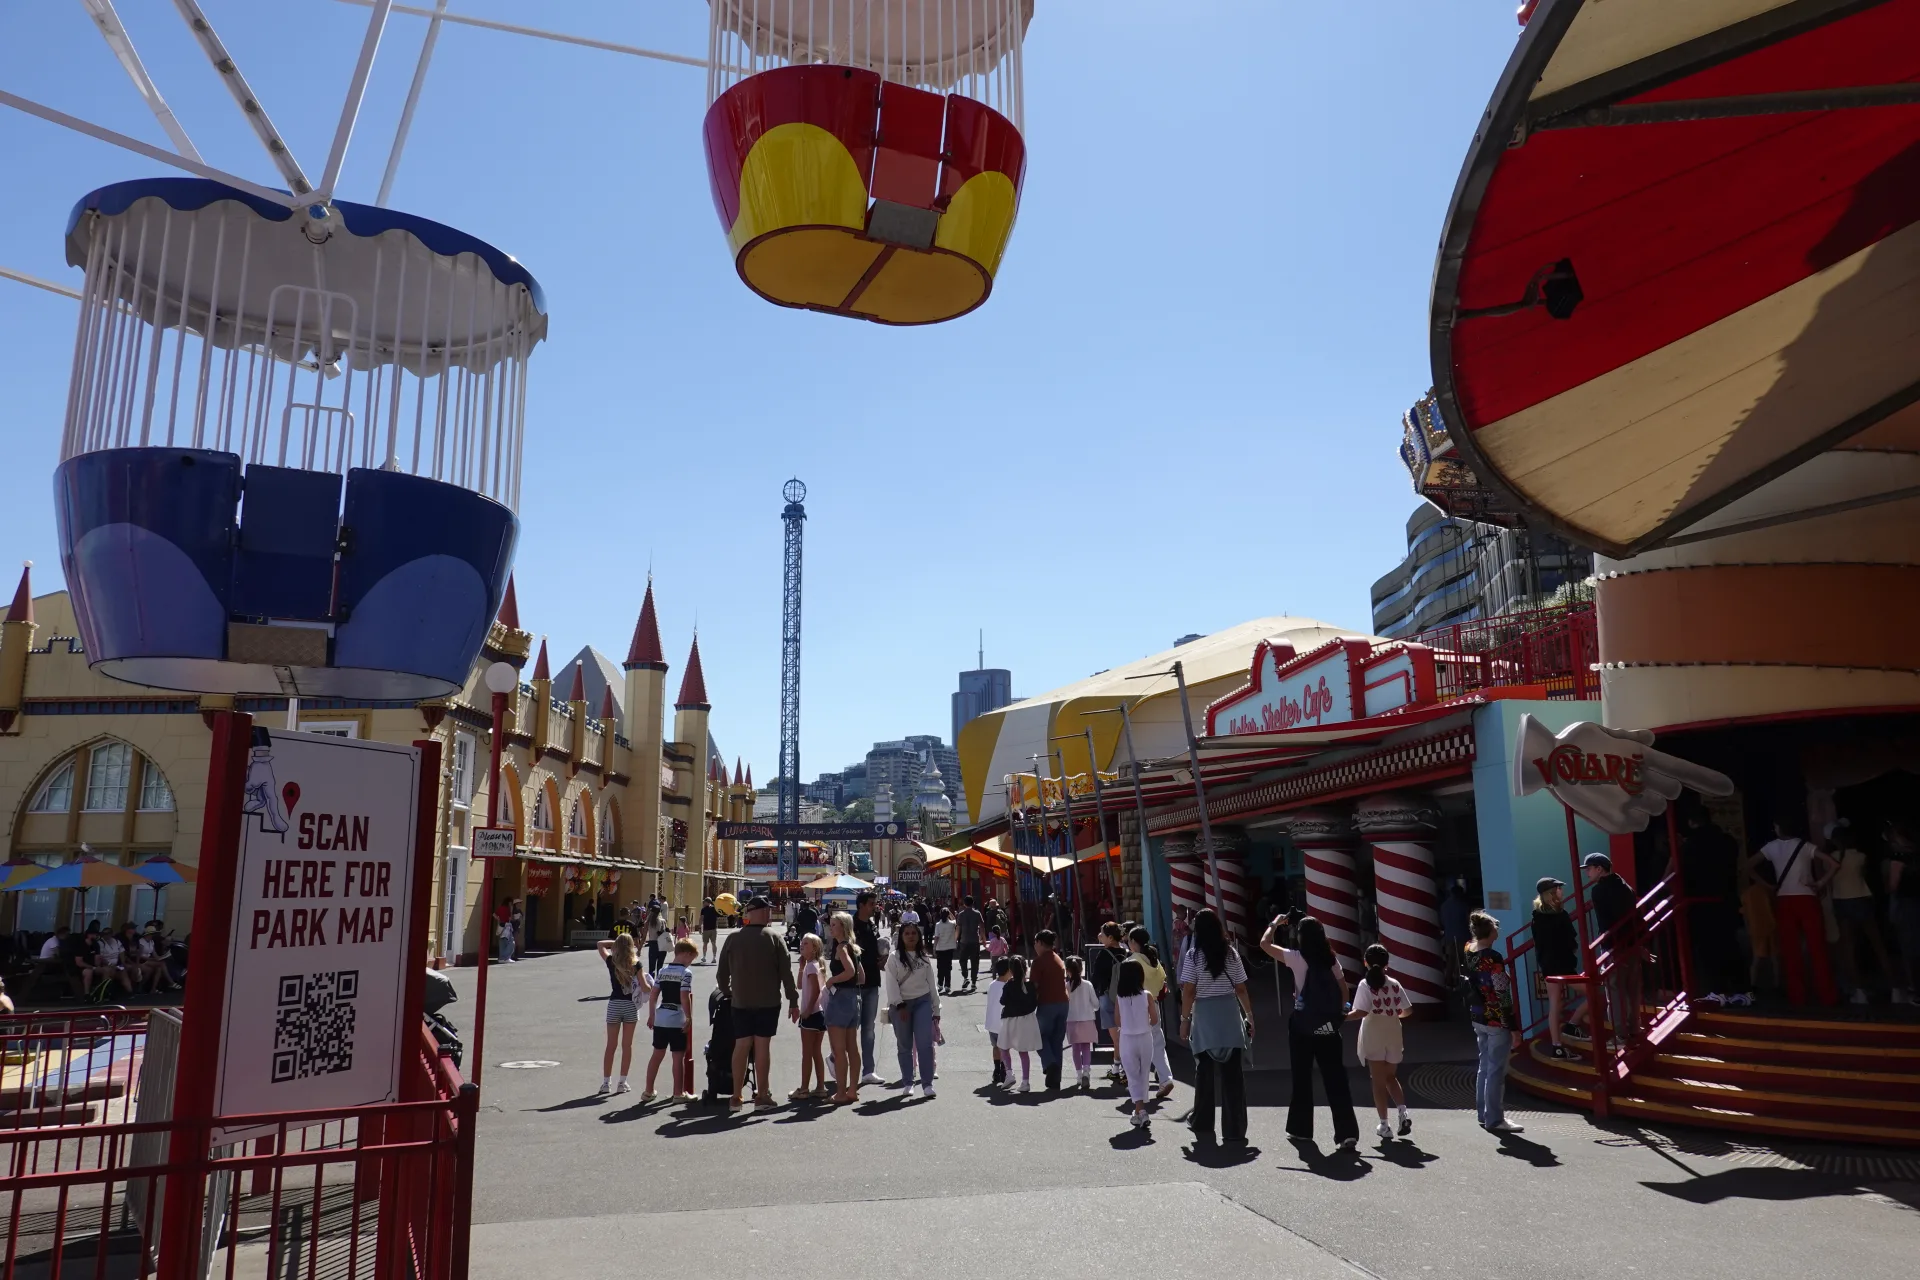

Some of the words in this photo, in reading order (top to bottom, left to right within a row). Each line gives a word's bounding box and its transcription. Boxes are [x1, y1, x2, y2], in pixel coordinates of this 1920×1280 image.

[1303, 676, 1333, 726] Cafe
[297, 812, 370, 851] SCAN
[476, 831, 502, 842] Please
[502, 832, 513, 842] NO
[724, 825, 749, 838] LUNA
[750, 825, 775, 839] PARK
[261, 859, 336, 898] HERE
[343, 861, 391, 898] FOR
[898, 872, 921, 880] FUNNY
[250, 908, 329, 949] PARK
[336, 906, 394, 945] MAP
